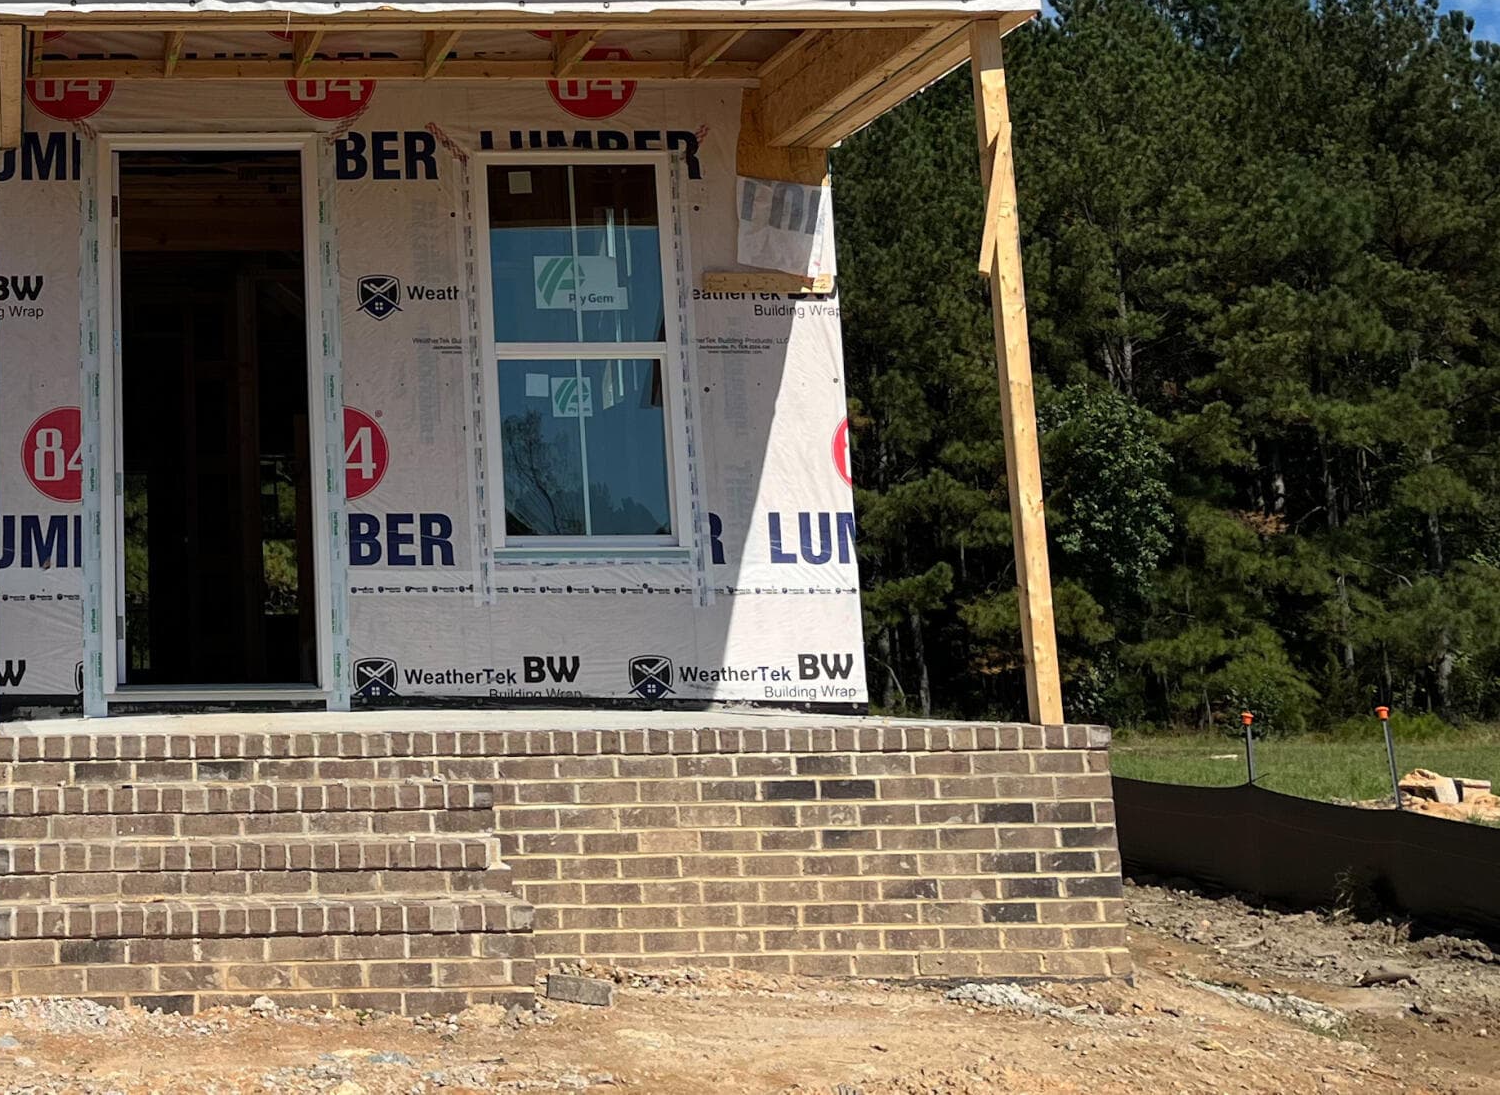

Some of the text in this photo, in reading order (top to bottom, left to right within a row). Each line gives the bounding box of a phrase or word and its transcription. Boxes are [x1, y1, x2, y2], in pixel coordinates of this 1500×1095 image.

[335, 131, 439, 180] BER
[568, 293, 614, 306] Py Gem
[10, 307, 44, 320] Wrap
[754, 304, 805, 318] Building
[348, 513, 456, 566] BER
[404, 656, 580, 685] WeatherTek BW
[680, 653, 853, 682] WeatherTek BW
[764, 686, 857, 699] Building Wrap
